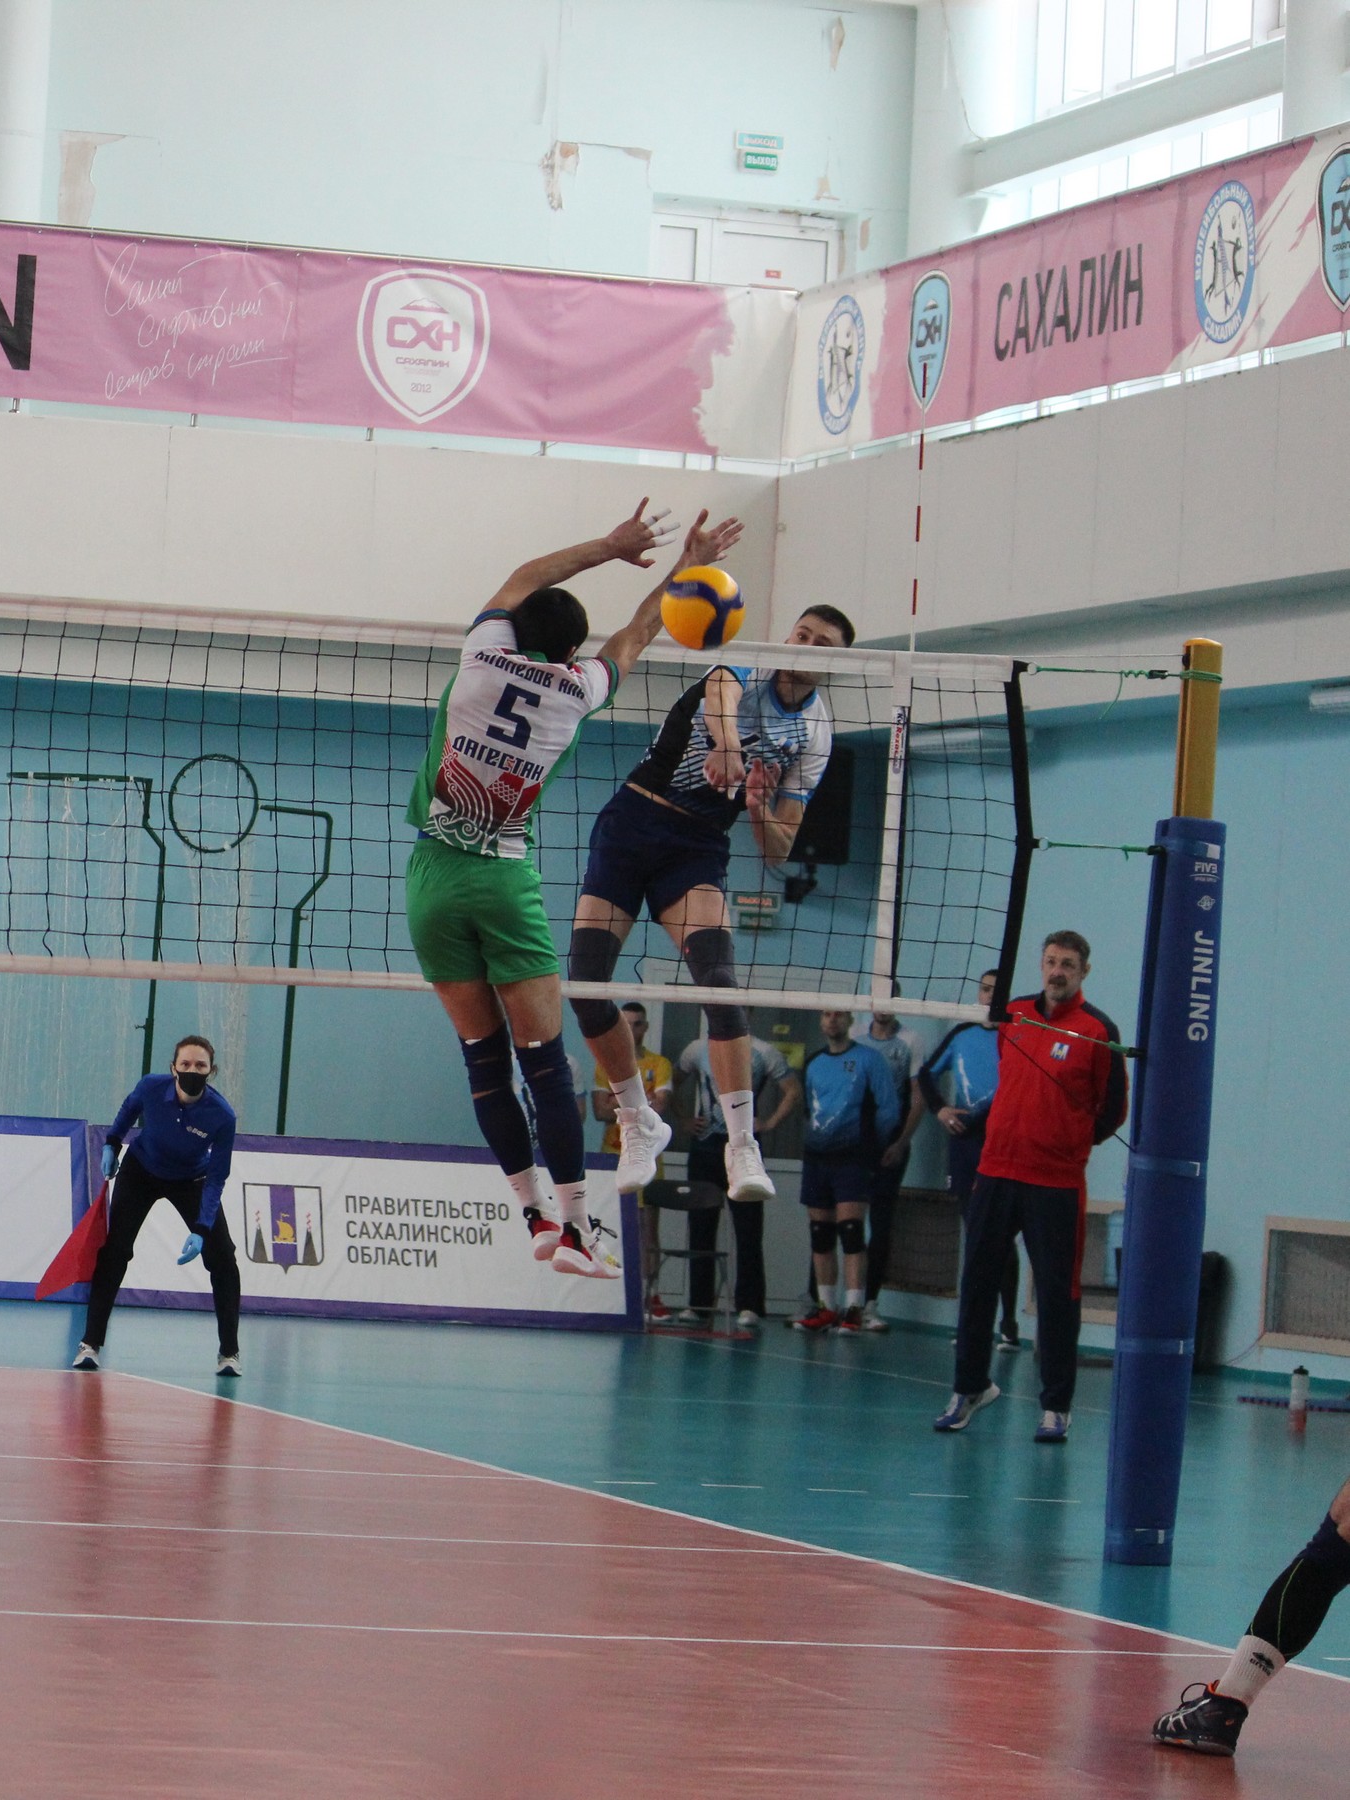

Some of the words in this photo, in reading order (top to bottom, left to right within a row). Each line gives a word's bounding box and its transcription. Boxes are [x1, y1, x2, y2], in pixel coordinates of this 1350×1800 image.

[746, 154, 778, 167] ВЫХОД
[994, 243, 1143, 361] САХАЛИН
[410, 382, 432, 393] 2012
[486, 682, 541, 750] 5
[1187, 930, 1215, 1042] JINLING
[345, 1195, 510, 1221] ПРАВИТЕЛЬСТВО
[346, 1220, 493, 1246] САХАЛИНСКОЙ
[347, 1246, 438, 1268] ОБЛАСТИ
